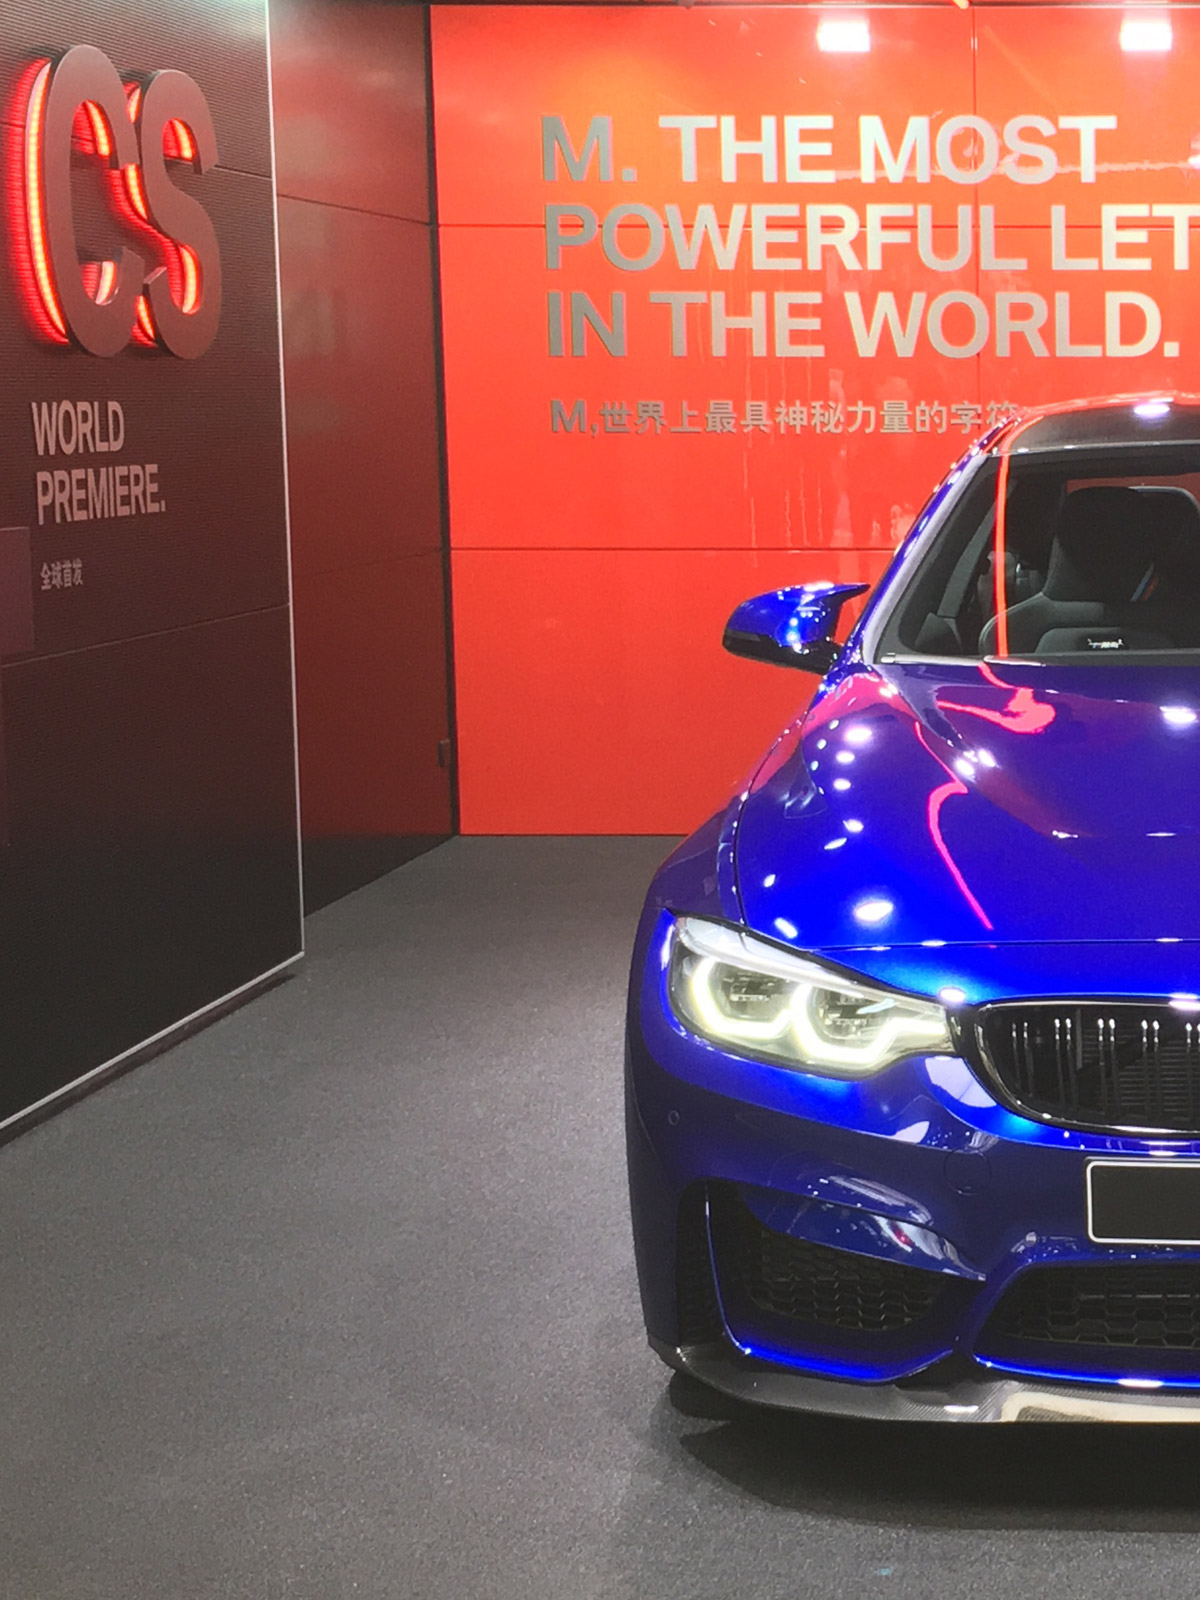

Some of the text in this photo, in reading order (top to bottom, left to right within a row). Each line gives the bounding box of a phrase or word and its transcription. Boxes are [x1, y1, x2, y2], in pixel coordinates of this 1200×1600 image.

[541, 115, 1117, 184] M. THE MOST
[44, 44, 222, 360] CS
[545, 204, 1028, 272] POWERFUL
[547, 290, 1180, 358] IN THE WORLD.
[31, 400, 125, 456] WORLD
[36, 463, 166, 525] PREMIERE.
[40, 558, 83, 590] 全球首发
